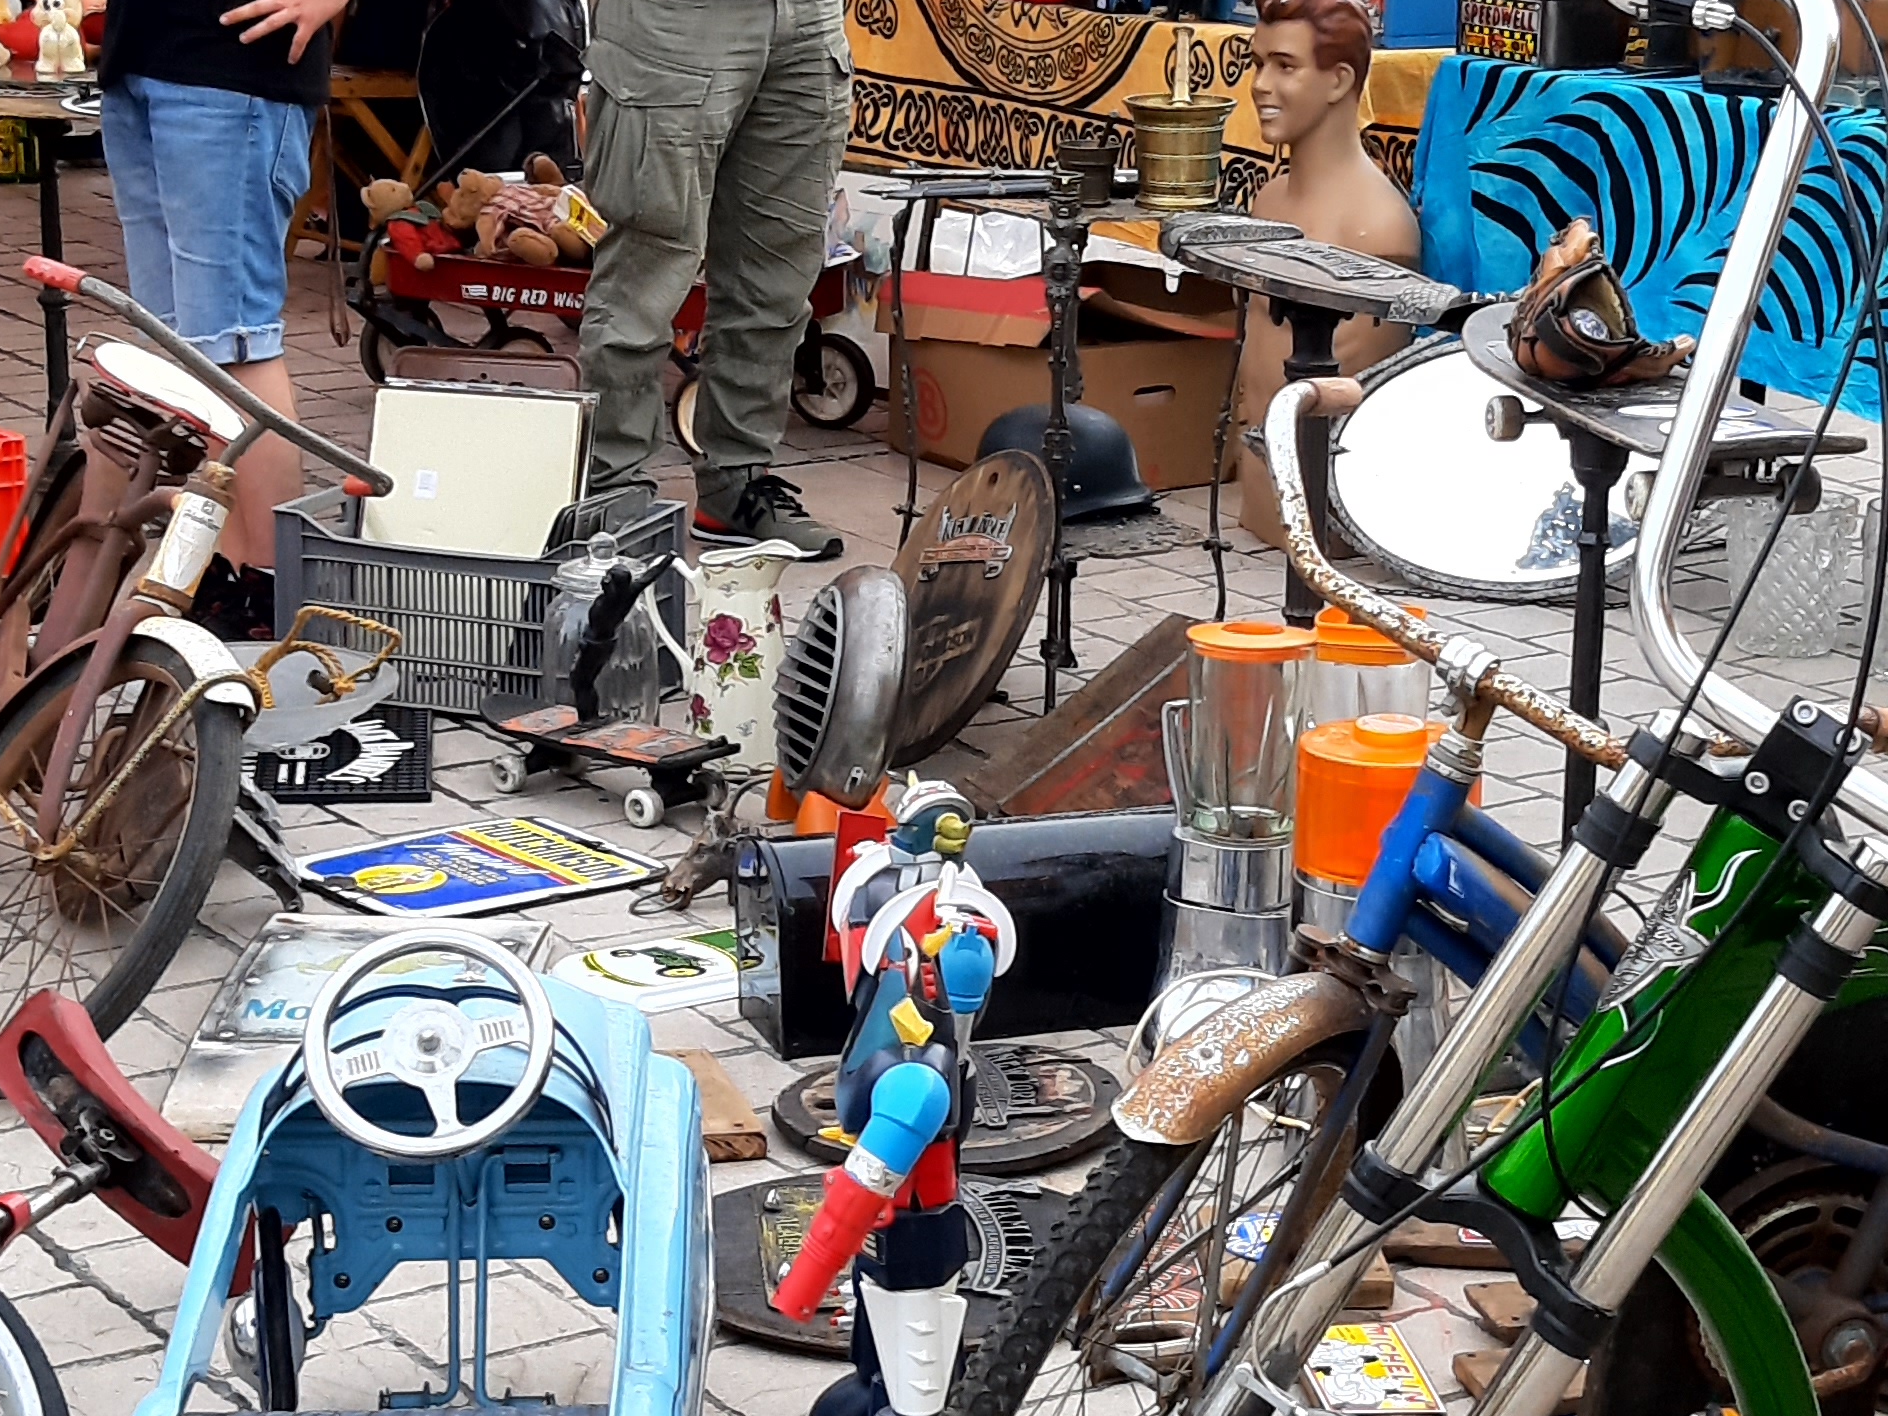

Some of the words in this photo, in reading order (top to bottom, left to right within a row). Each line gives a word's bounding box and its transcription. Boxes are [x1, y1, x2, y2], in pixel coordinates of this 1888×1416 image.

[1463, 1, 1536, 32] SPEEDWELL
[491, 285, 517, 303] BIG
[519, 288, 548, 306] RED
[469, 821, 639, 882] HUTCHINSON
[980, 1193, 1033, 1239] MIAMI
[1365, 1325, 1425, 1403] MICHELIN
